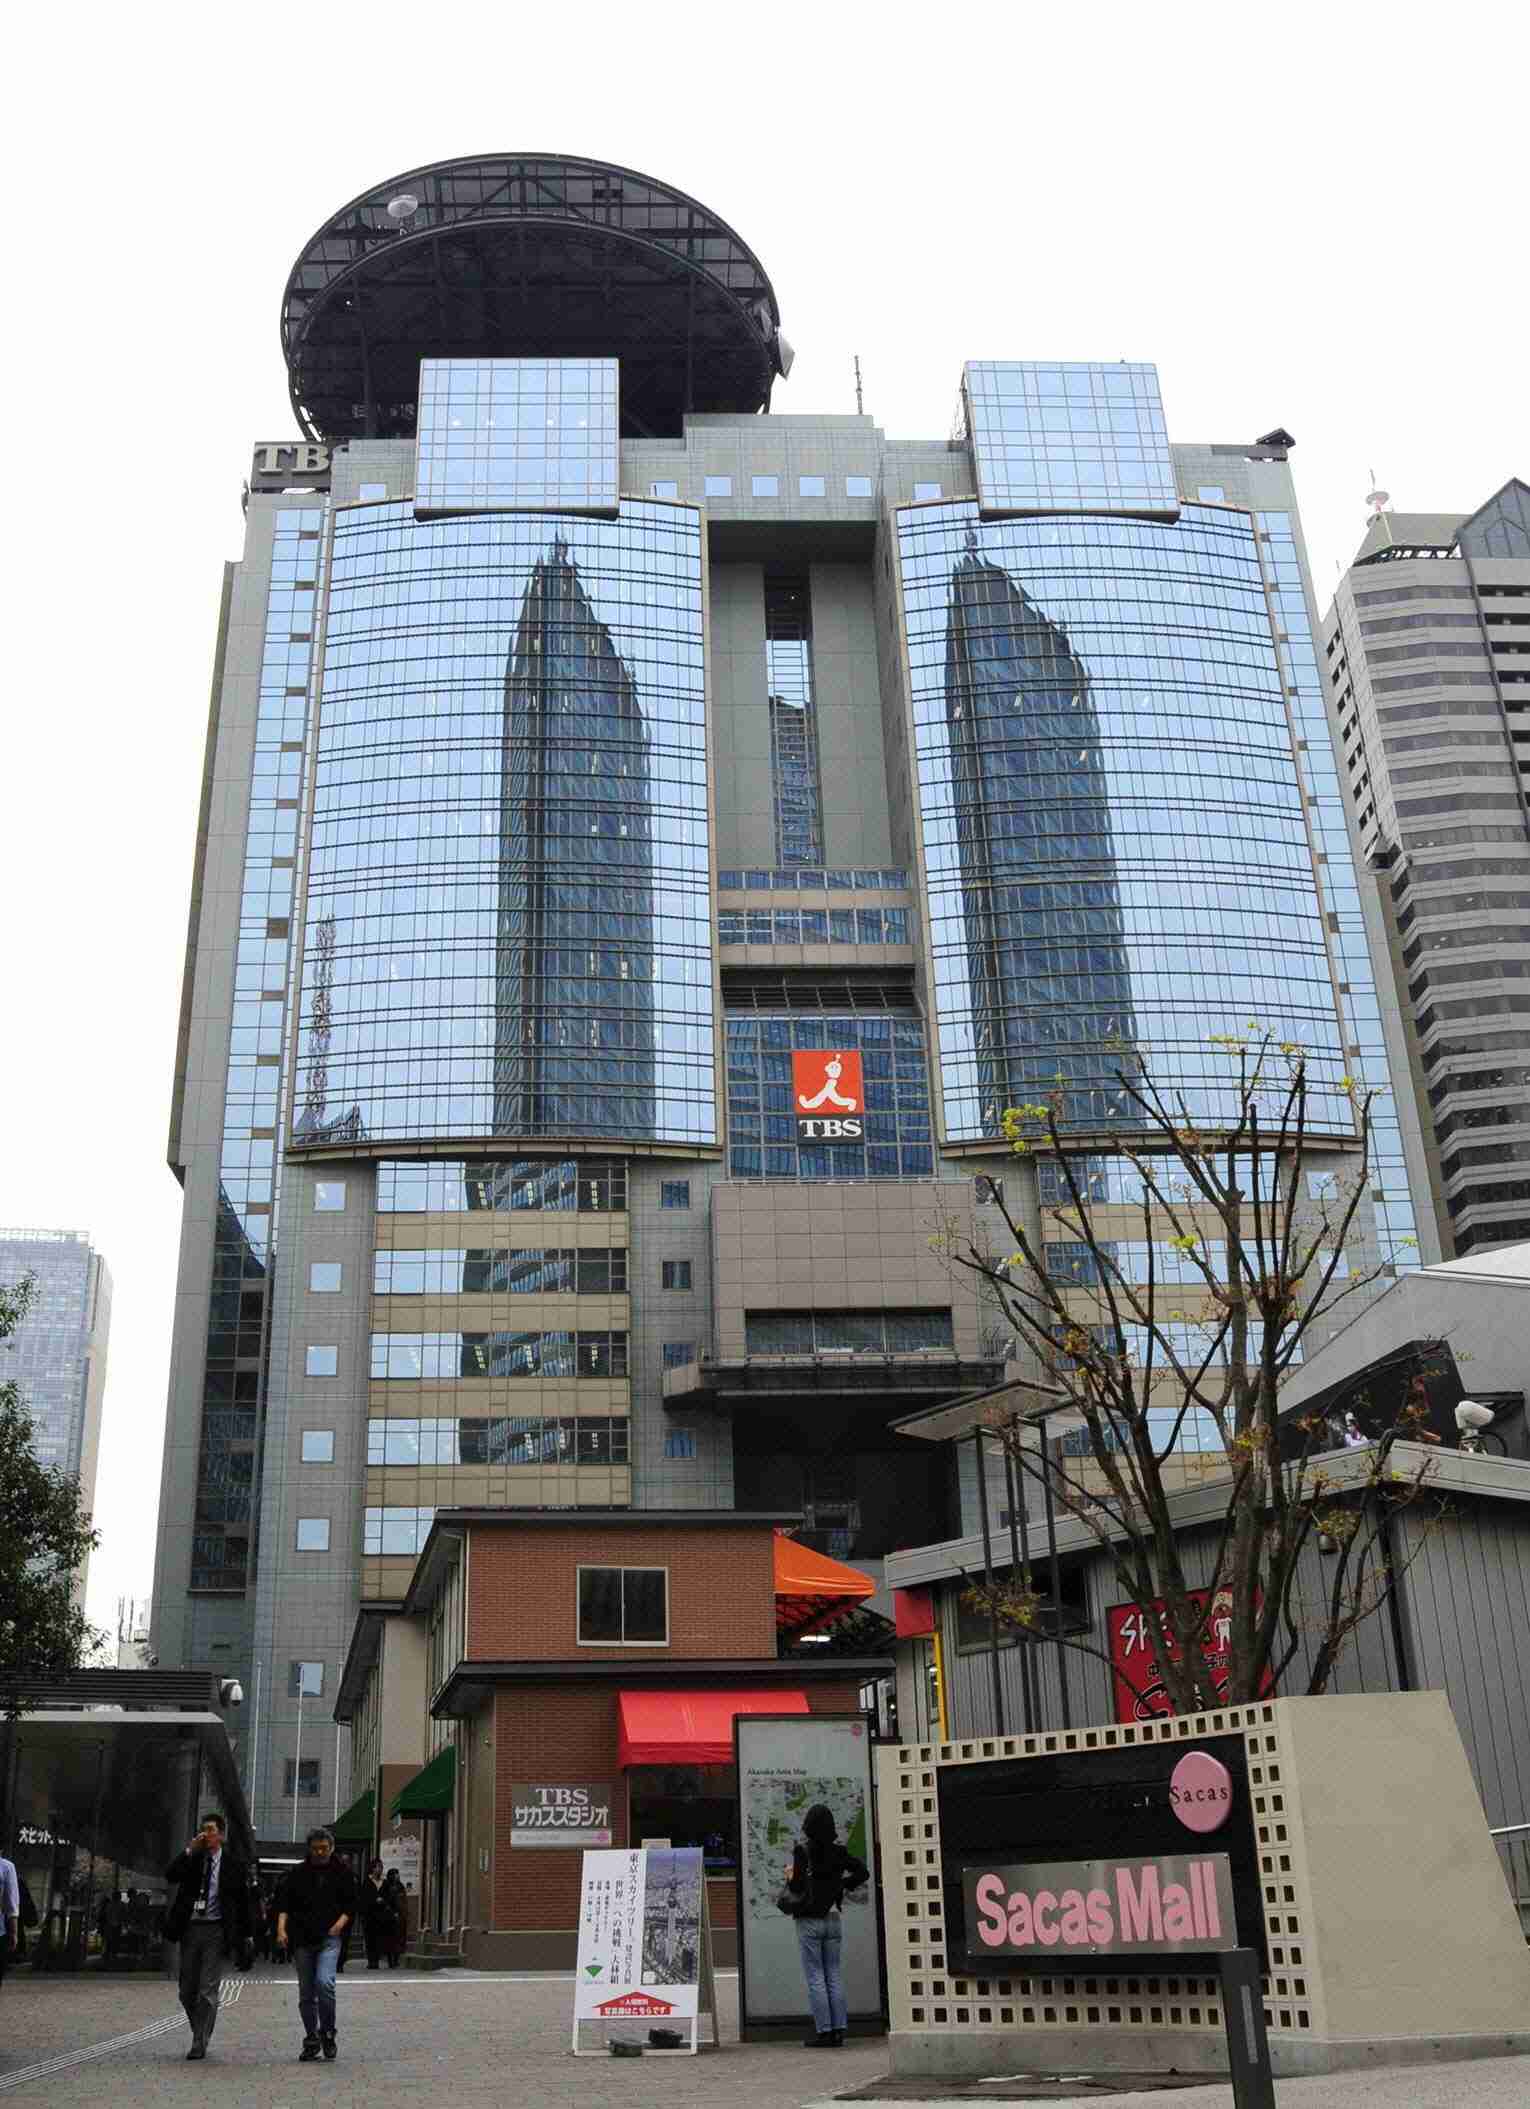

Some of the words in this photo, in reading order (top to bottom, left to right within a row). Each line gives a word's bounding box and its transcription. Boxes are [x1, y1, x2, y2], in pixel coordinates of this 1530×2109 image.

[255, 444, 349, 473] TB
[799, 1119, 862, 1137] TBS
[535, 1788, 588, 1805] TBS
[1170, 1785, 1230, 1806] Sacas
[515, 1806, 609, 1826] サカススタジオ
